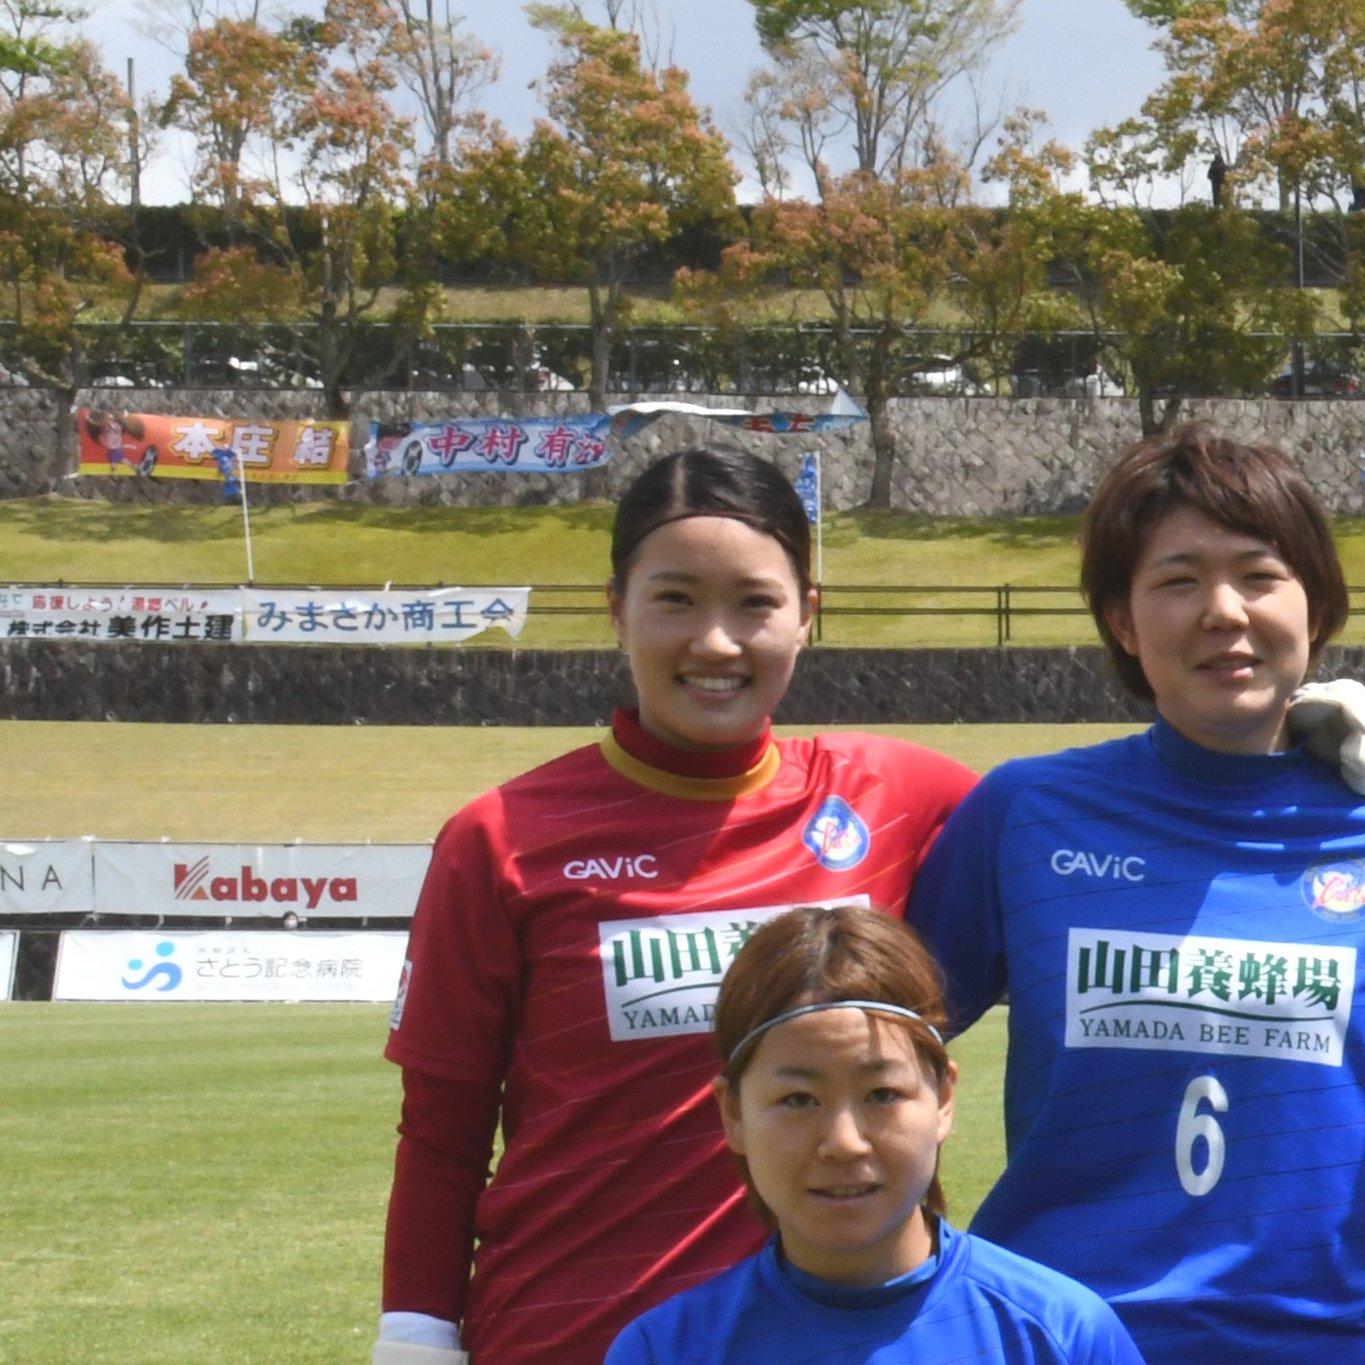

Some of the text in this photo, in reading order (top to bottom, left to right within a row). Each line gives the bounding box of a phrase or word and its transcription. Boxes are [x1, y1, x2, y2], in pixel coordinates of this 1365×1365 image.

[173, 855, 357, 909] Kabaya
[1077, 940, 1342, 1011] 山田養蜂場
[622, 1003, 716, 1031] YAMAD
[1080, 1017, 1331, 1054] YAMADA BEE FARM
[1174, 1075, 1229, 1197] 6
